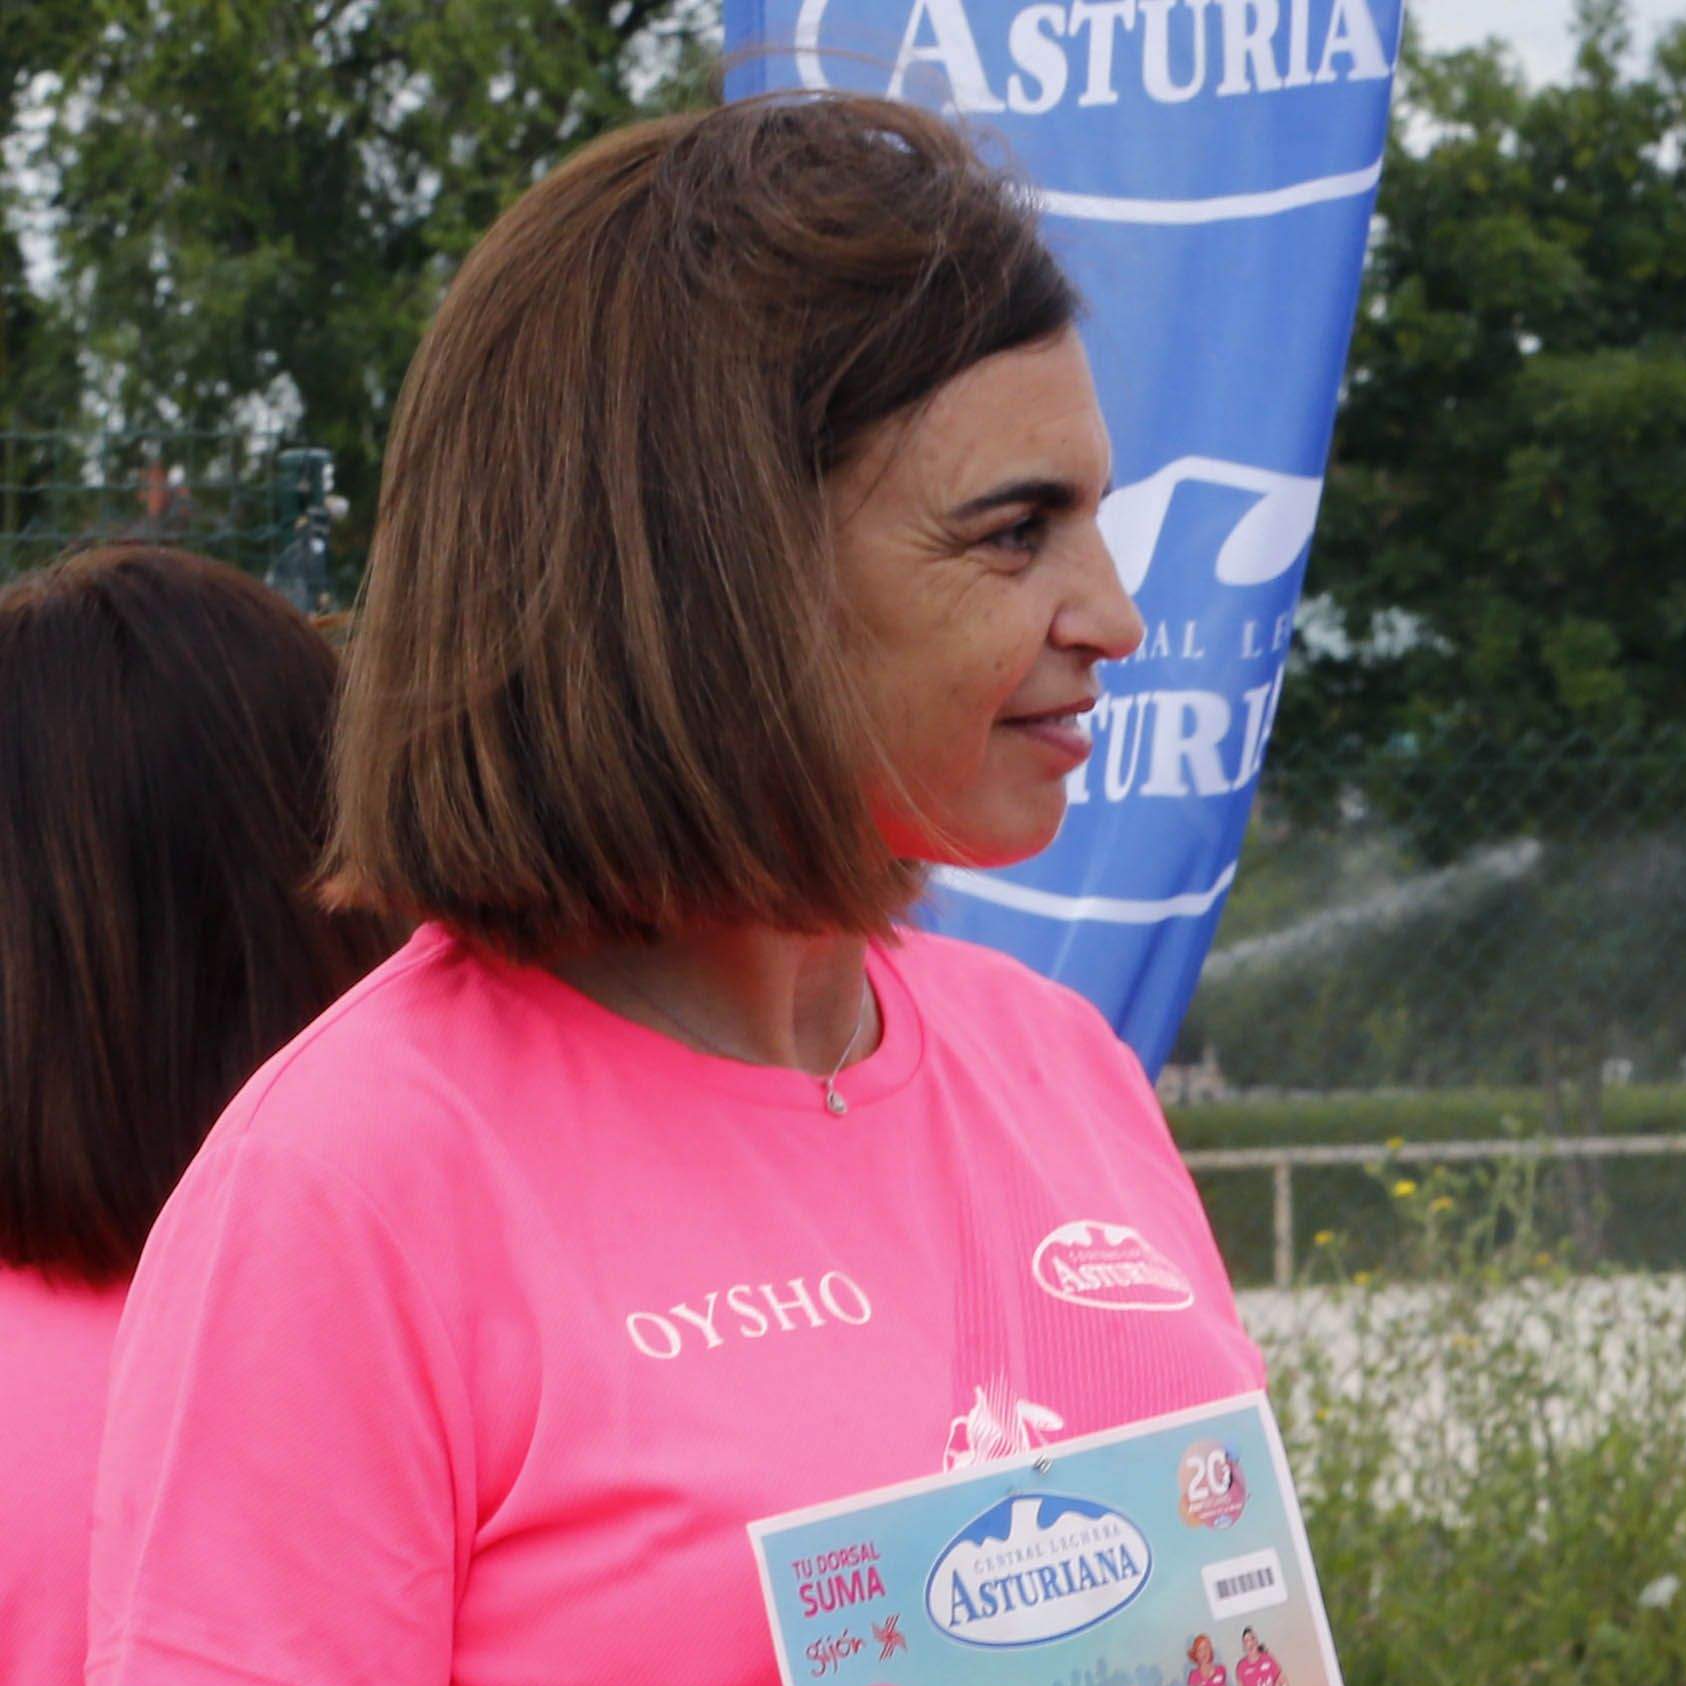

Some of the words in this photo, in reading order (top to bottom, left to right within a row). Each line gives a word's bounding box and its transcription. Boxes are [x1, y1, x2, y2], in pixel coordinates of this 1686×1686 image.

[884, 0, 1397, 115] ASTURIA
[1133, 619, 1206, 663] AL
[1064, 664, 1285, 806] TURI
[625, 1269, 873, 1361] OYSHO
[1185, 1447, 1232, 1502] 20
[791, 1556, 819, 1580] TU
[818, 1540, 882, 1575] DORSAL
[798, 1564, 887, 1620] SUMA
[948, 1541, 1141, 1629] ASTURIANA
